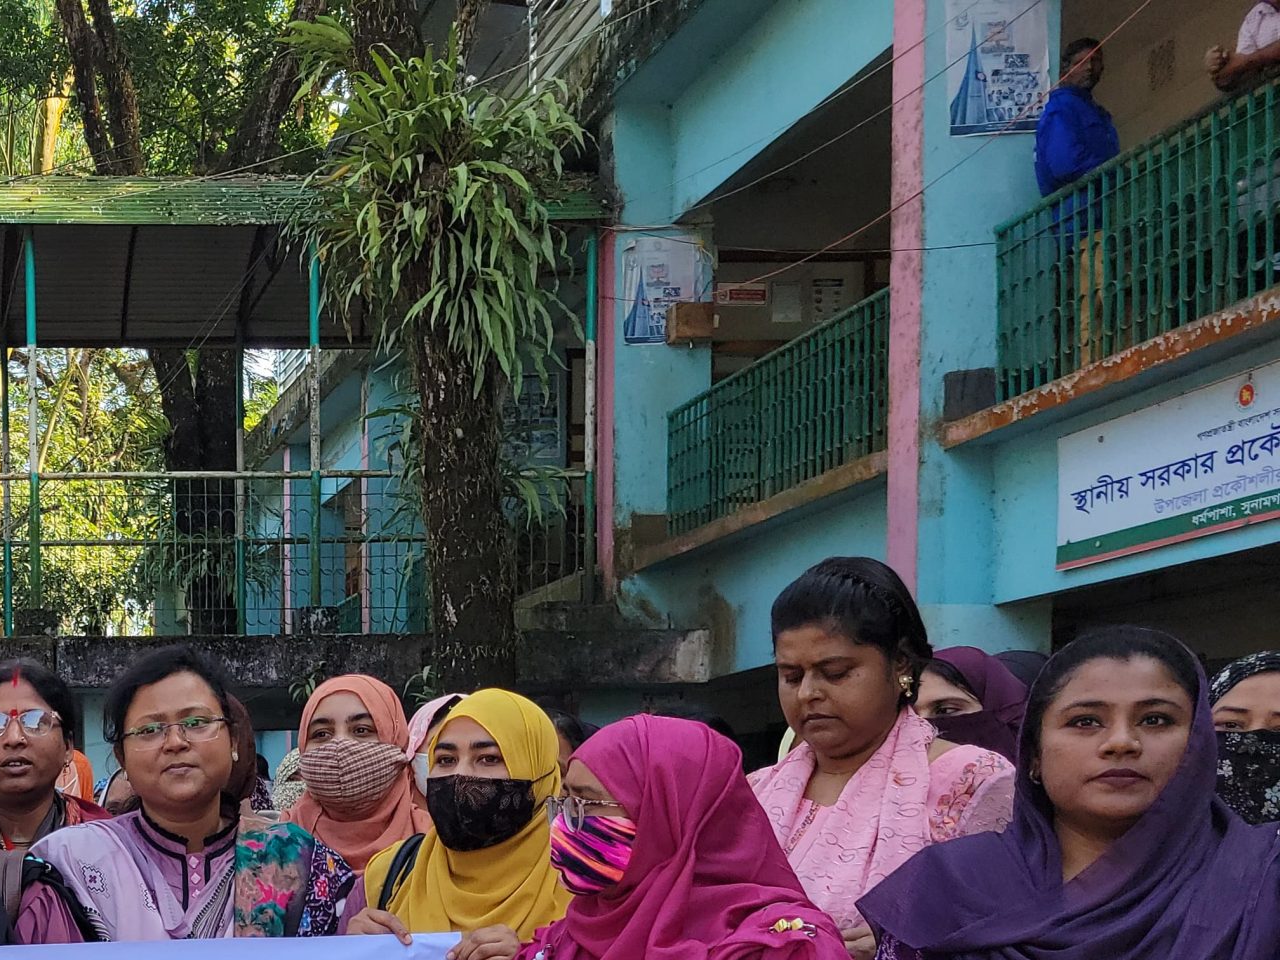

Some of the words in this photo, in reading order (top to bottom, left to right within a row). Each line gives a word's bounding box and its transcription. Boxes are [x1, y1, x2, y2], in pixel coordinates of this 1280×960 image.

[1071, 475, 1132, 514] স্থানীয়
[1138, 451, 1217, 491] সরকার
[1154, 489, 1206, 514] উপজেলা
